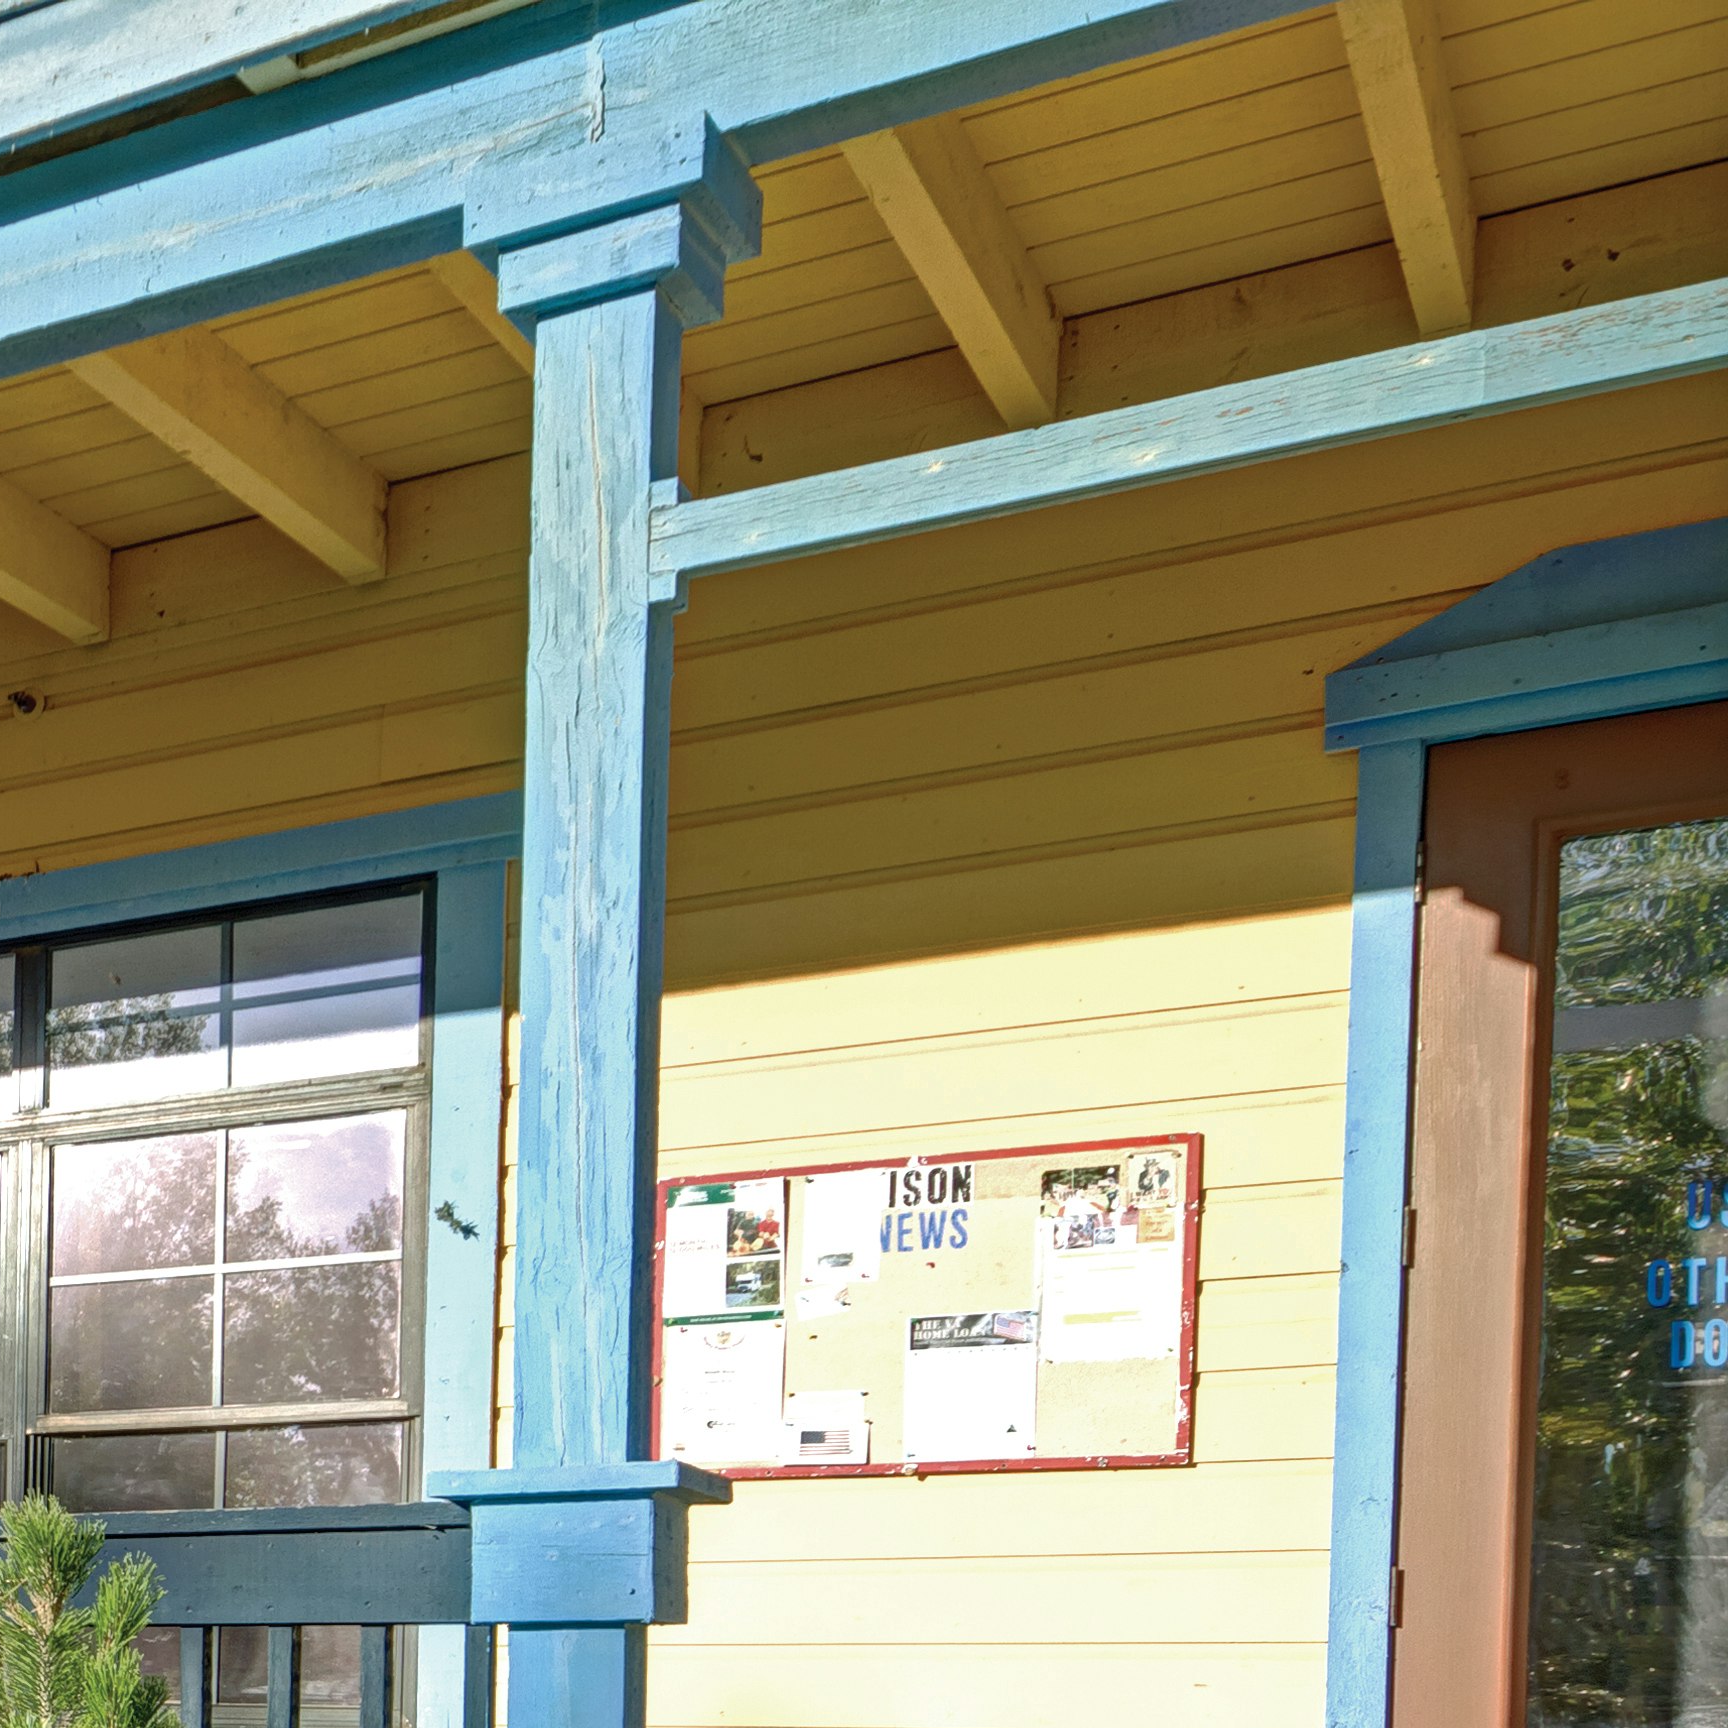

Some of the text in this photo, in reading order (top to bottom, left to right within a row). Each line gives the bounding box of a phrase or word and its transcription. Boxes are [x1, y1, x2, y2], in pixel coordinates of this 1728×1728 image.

[888, 1165, 972, 1208] ISON
[880, 1208, 968, 1253] NEWS
[1670, 1318, 1728, 1369] DO
